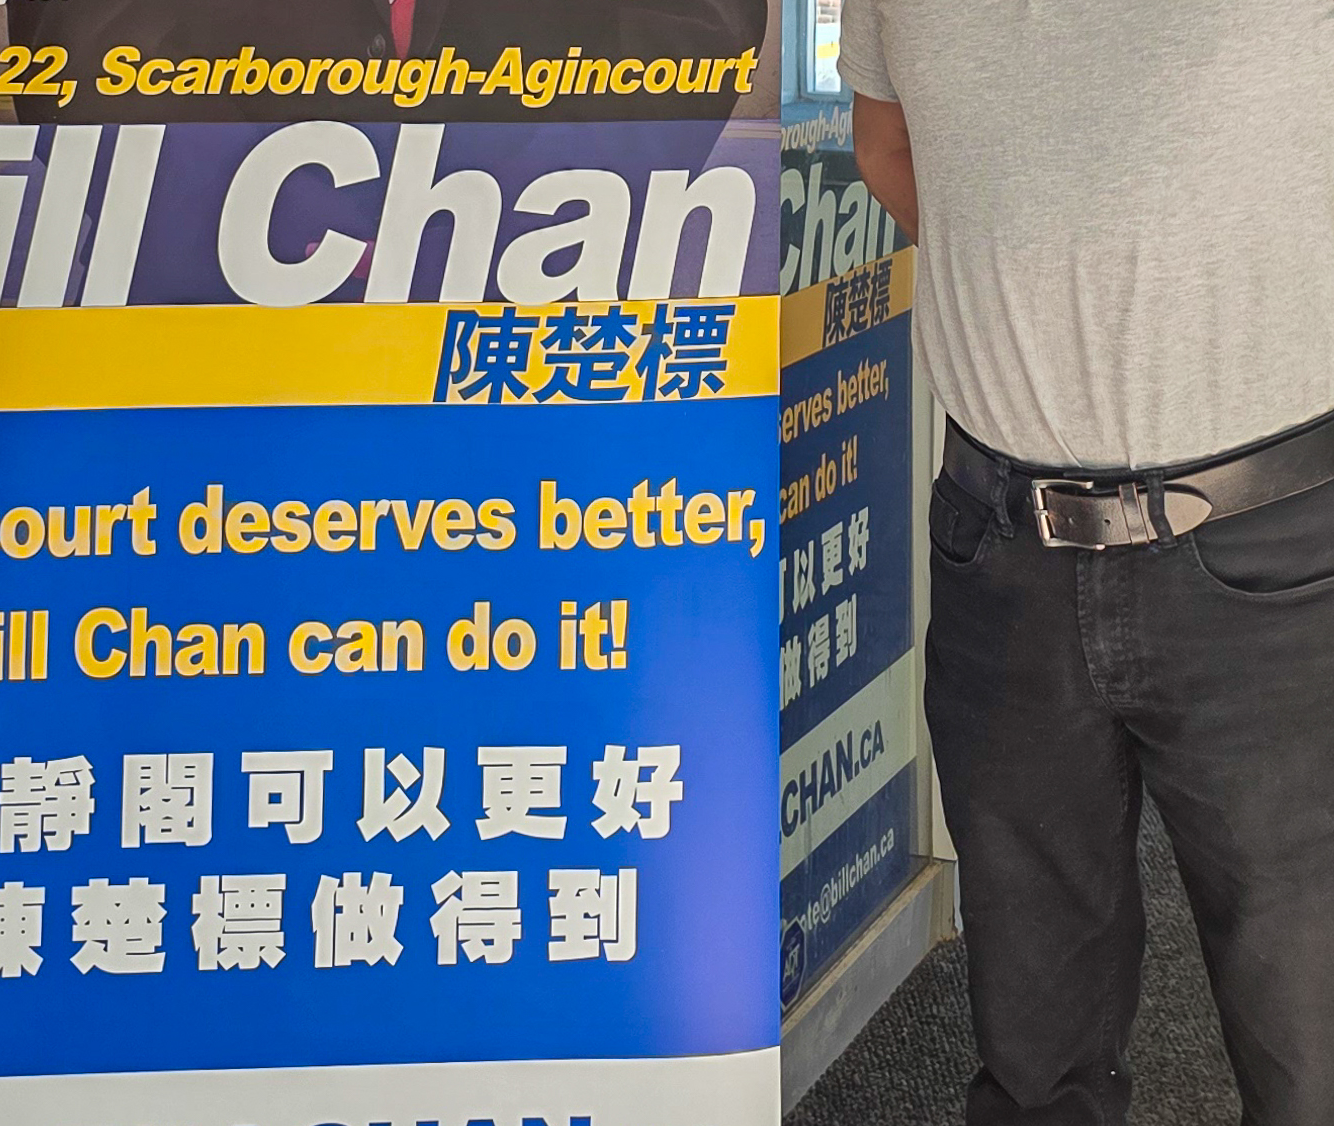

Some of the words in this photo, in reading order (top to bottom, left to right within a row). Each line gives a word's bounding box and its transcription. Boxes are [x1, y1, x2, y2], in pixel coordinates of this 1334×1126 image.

[95, 45, 759, 108] Scarborough-Agincourt
[217, 122, 759, 308] Chan
[822, 258, 893, 349] 陳楚標
[433, 304, 735, 403] 陳楚標
[779, 386, 833, 445] erves
[836, 357, 890, 416] better,
[178, 485, 516, 556] deserves
[539, 479, 766, 559] better,
[778, 474, 810, 525] can
[815, 452, 837, 502] do
[841, 434, 858, 487] it!
[74, 607, 266, 681] Chan
[288, 618, 424, 675] can
[446, 603, 537, 671] do
[559, 600, 629, 671] it!
[779, 719, 885, 845] CHAN.CA
